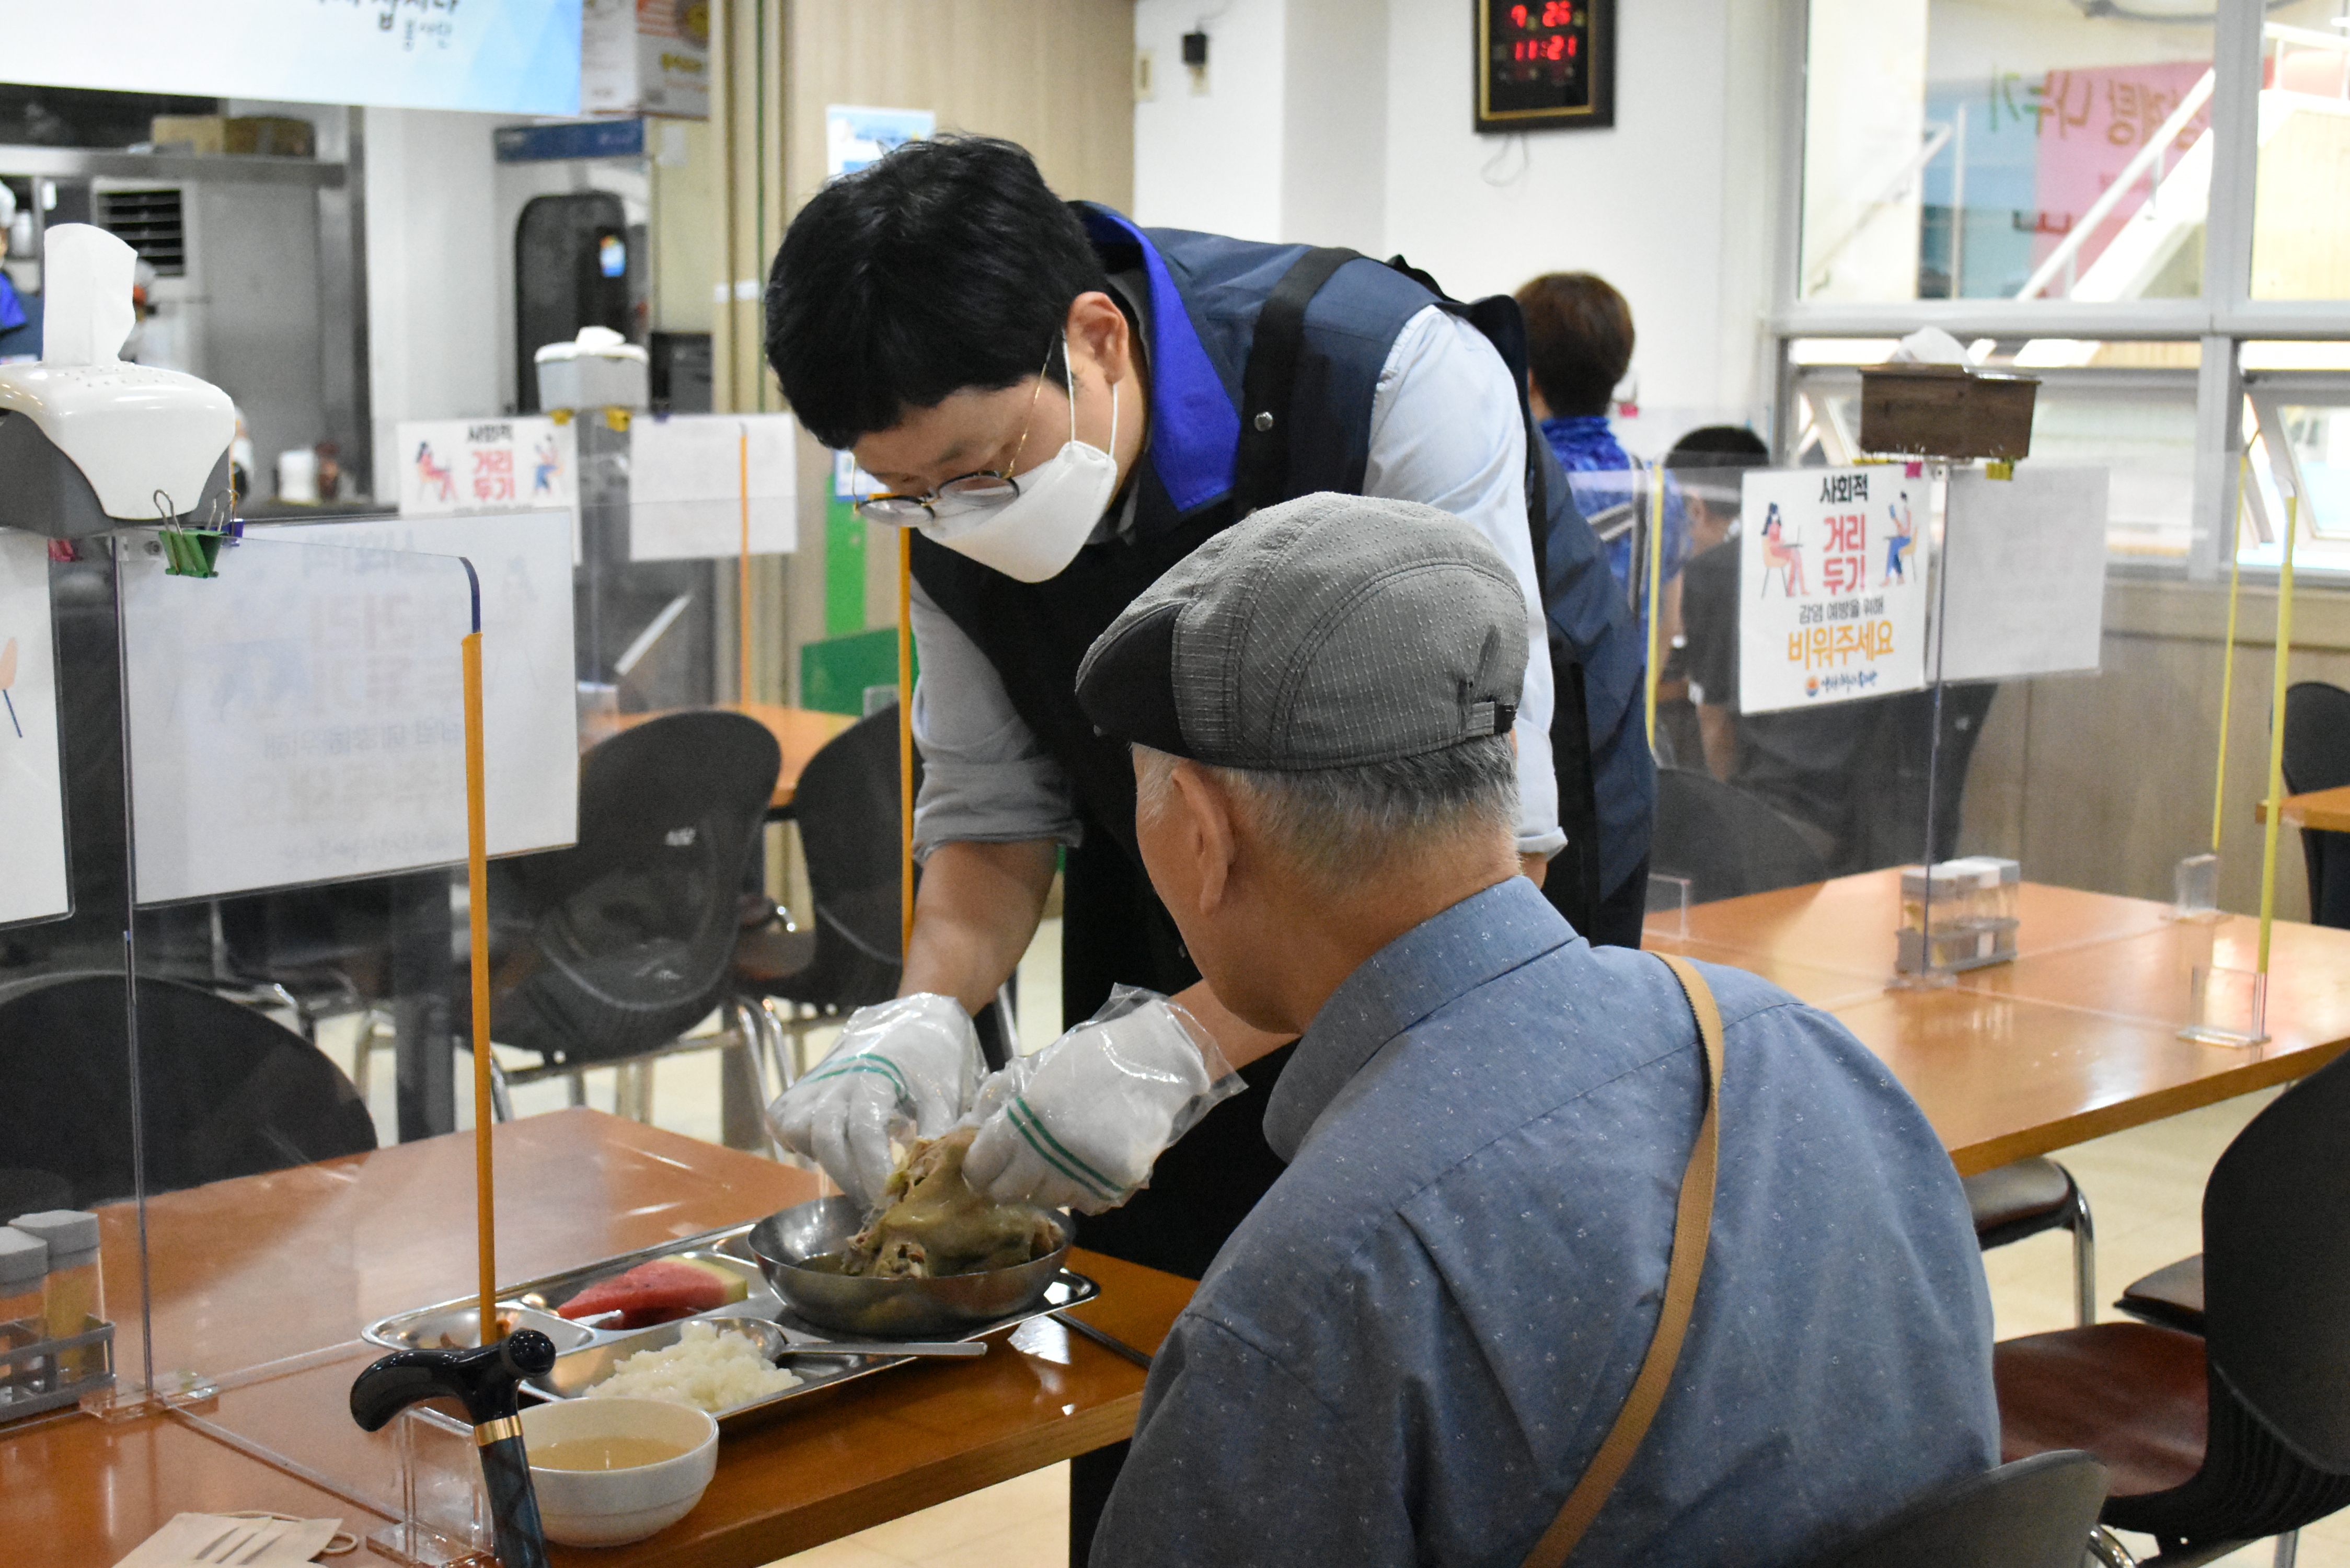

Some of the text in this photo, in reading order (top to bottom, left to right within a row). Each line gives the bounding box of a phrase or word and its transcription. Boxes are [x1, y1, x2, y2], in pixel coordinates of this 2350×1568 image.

[1515, 34, 1577, 61] 11:21
[1819, 472, 1869, 504] 사회적
[1823, 513, 1866, 553] 거리
[1823, 554, 1866, 596] 두기
[1800, 603, 1824, 625] 감염
[1827, 598, 1859, 620] 예방을
[1788, 619, 1894, 670] 비워주세요
